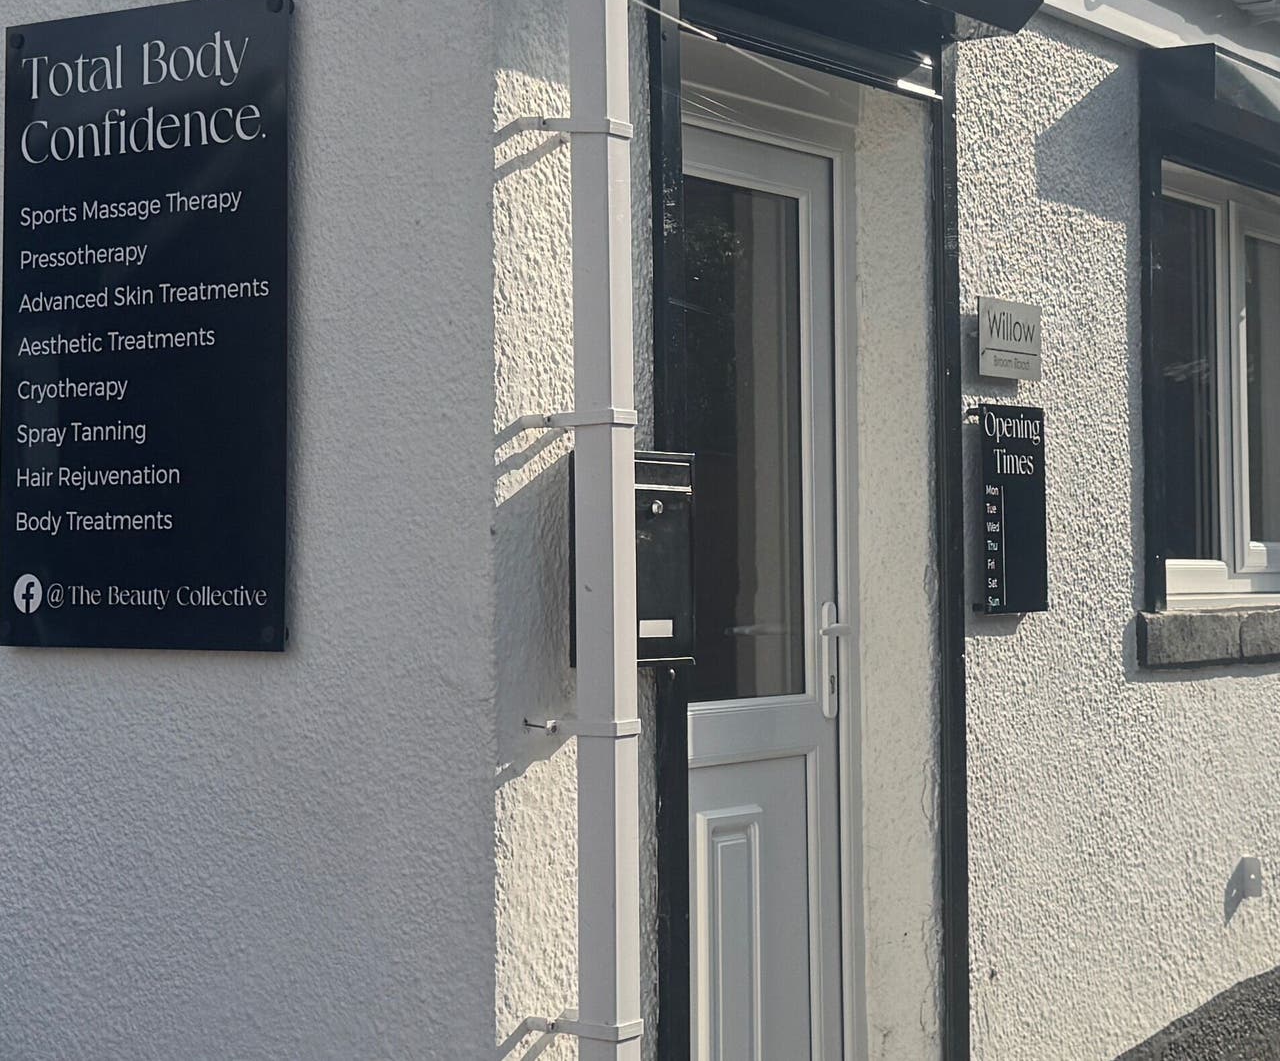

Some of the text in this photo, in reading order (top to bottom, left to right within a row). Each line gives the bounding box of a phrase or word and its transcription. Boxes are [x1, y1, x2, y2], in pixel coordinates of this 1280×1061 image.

[22, 30, 249, 100] Total Body
[21, 104, 267, 164] Confidence.
[20, 190, 242, 229] Sports Massage Therapy
[20, 243, 148, 270] Pressotherapy
[19, 278, 270, 313] Advanced Skin Treatments
[987, 309, 1036, 344] Willow
[18, 327, 216, 356] Aesthetic Treatments
[17, 378, 128, 404] Cryotherapy
[16, 420, 147, 447] Spray Tanning
[984, 410, 1041, 445] Opening
[993, 448, 1034, 476] Times
[16, 464, 181, 491] Hair Rejuvenation
[985, 484, 1000, 496] Mon
[986, 502, 997, 514] Tue
[15, 510, 173, 536] Body Treatments
[986, 521, 1000, 533] Wed
[986, 539, 998, 551] Thu
[987, 558, 996, 570] Fri
[988, 577, 998, 588] Sat
[67, 584, 102, 606] The
[107, 584, 170, 610] Beauty
[176, 584, 268, 607] Collective
[988, 596, 1000, 607] Sun
